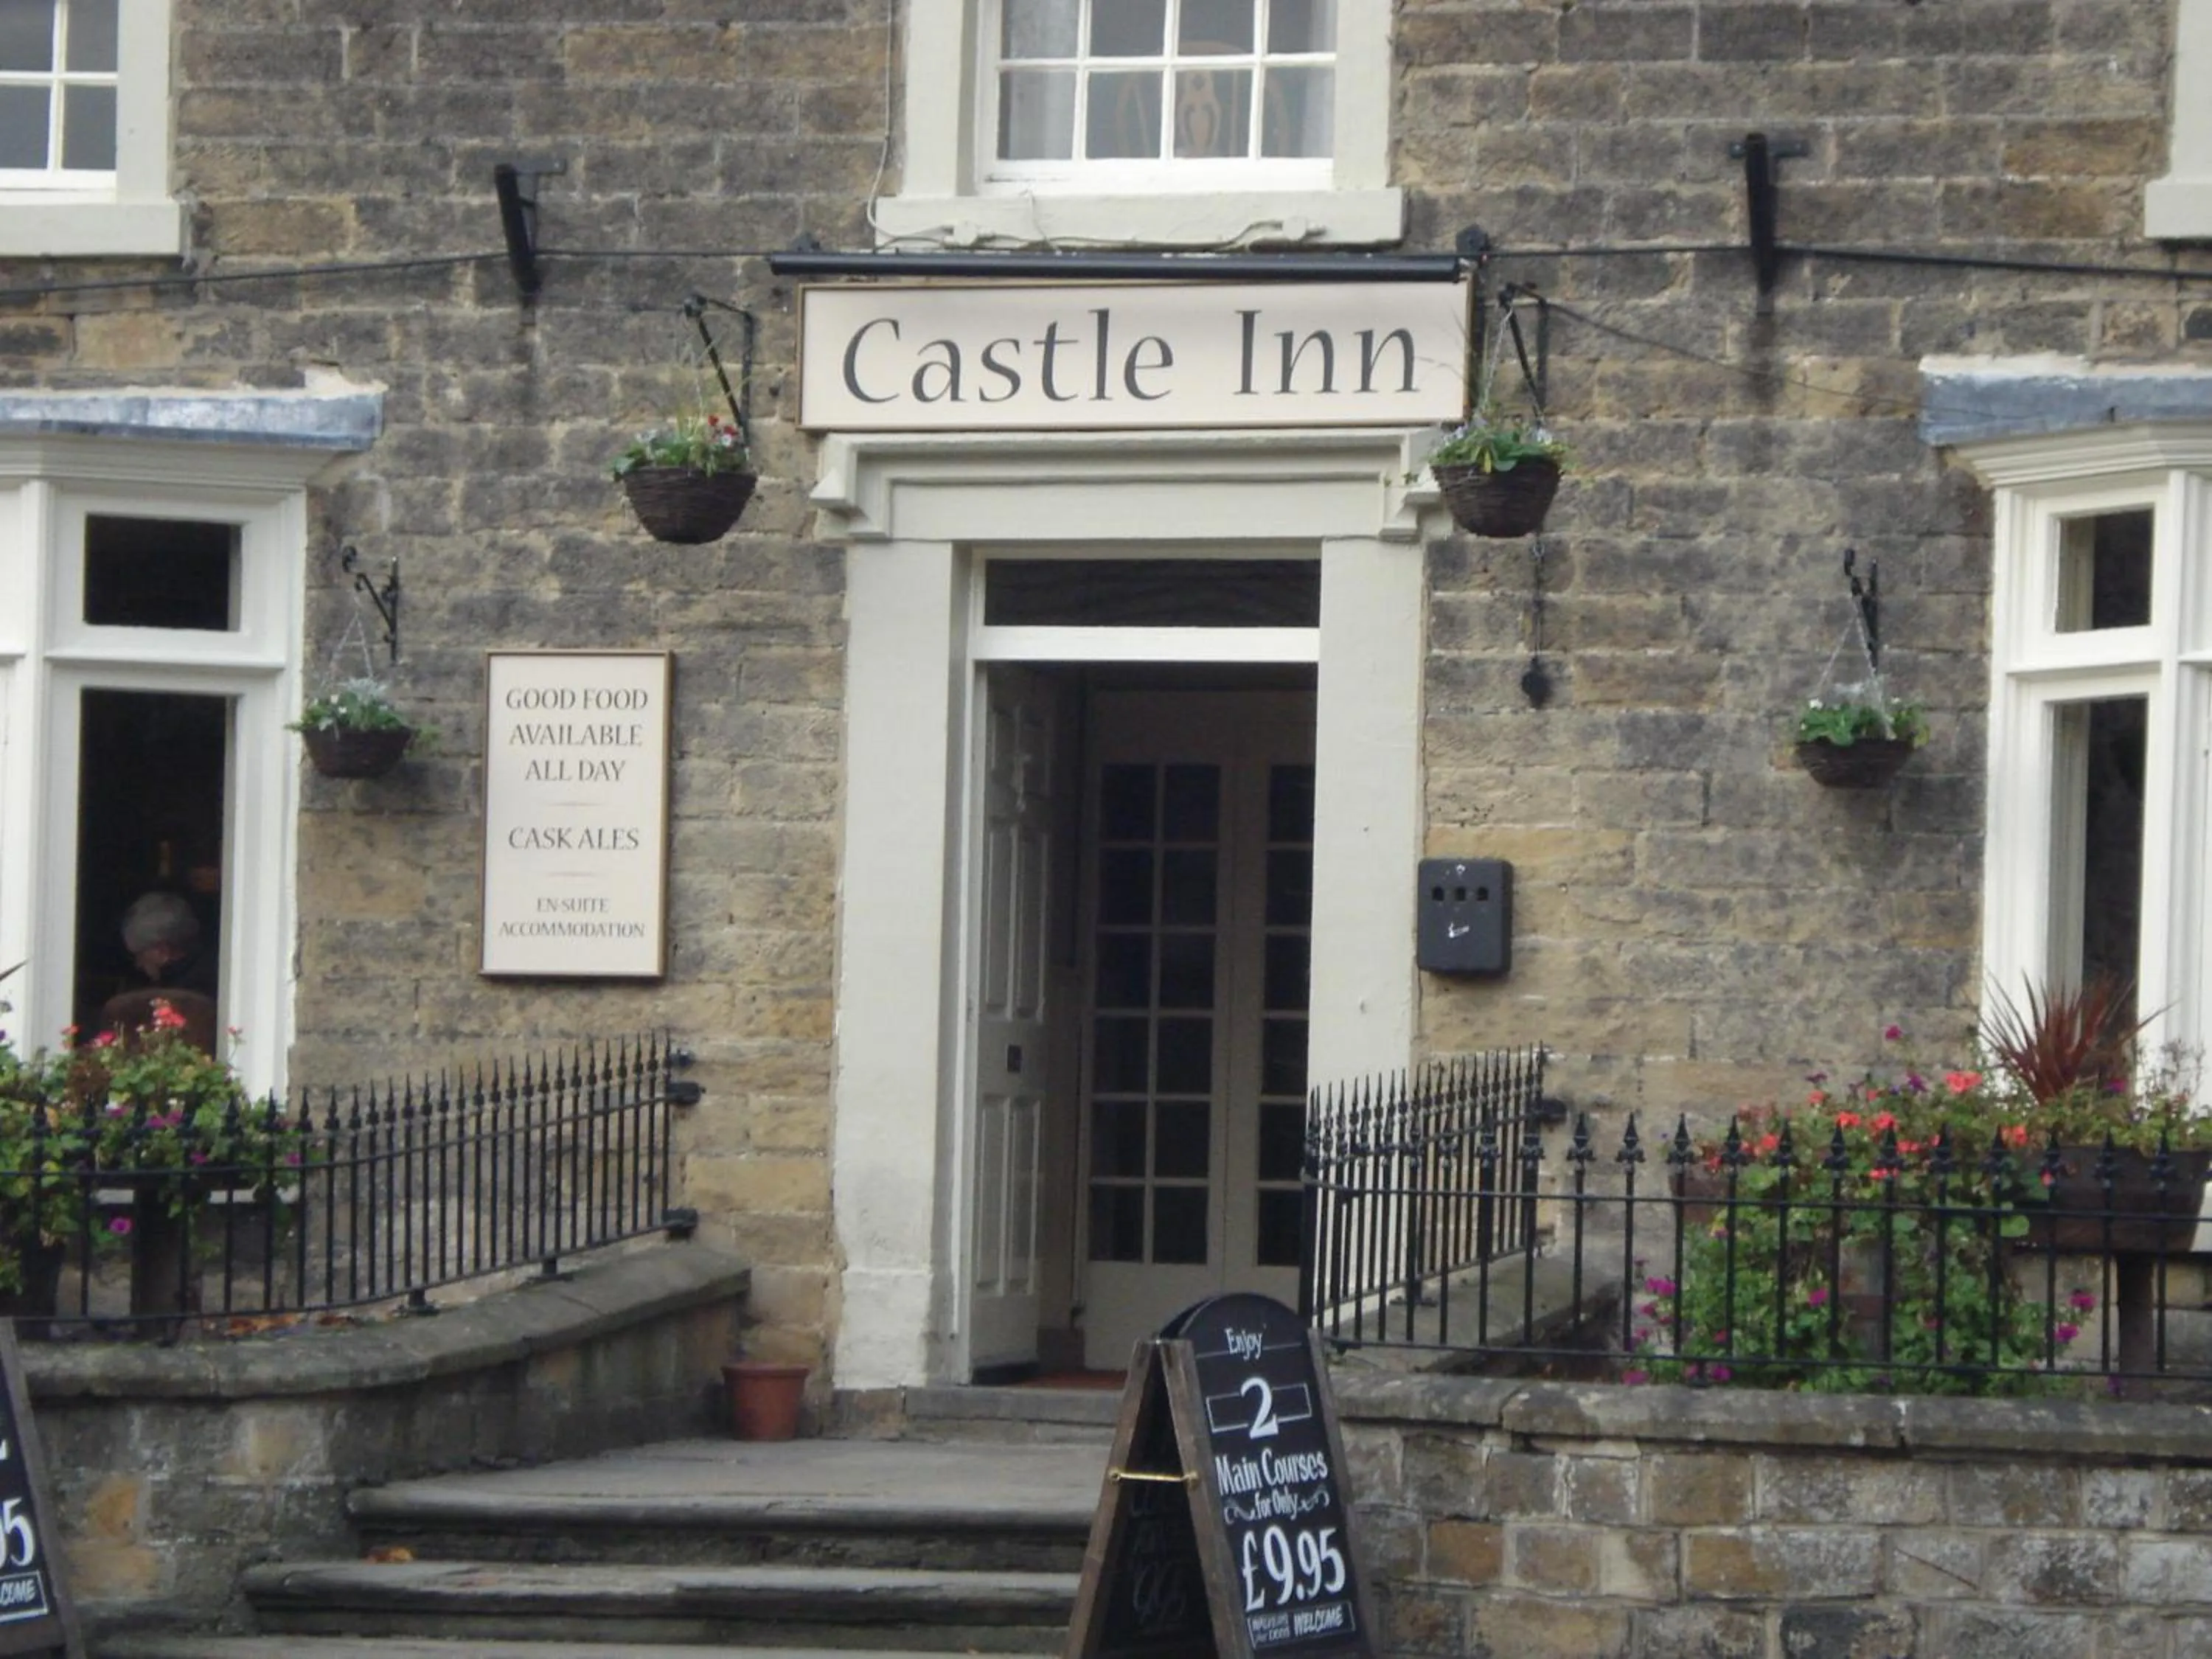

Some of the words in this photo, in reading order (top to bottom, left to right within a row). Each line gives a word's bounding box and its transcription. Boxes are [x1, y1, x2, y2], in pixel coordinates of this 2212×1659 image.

[842, 307, 1175, 403] Castle
[1233, 310, 1421, 396] Inn
[506, 688, 576, 710] GOOD
[582, 688, 648, 710] FOOD
[508, 723, 643, 746] AVAILABLE
[524, 759, 572, 782] ALL
[578, 759, 626, 782] DAY
[508, 827, 571, 849] CASK
[577, 827, 639, 850] ALES
[498, 921, 646, 938] ACCOMMODATION
[1225, 1327, 1262, 1361] Enjoy
[1240, 1377, 1279, 1439] 2
[1215, 1454, 1263, 1496] Main
[1262, 1447, 1328, 1486] Courses
[1272, 1485, 1298, 1520] Only
[1242, 1526, 1346, 1613] £9.95
